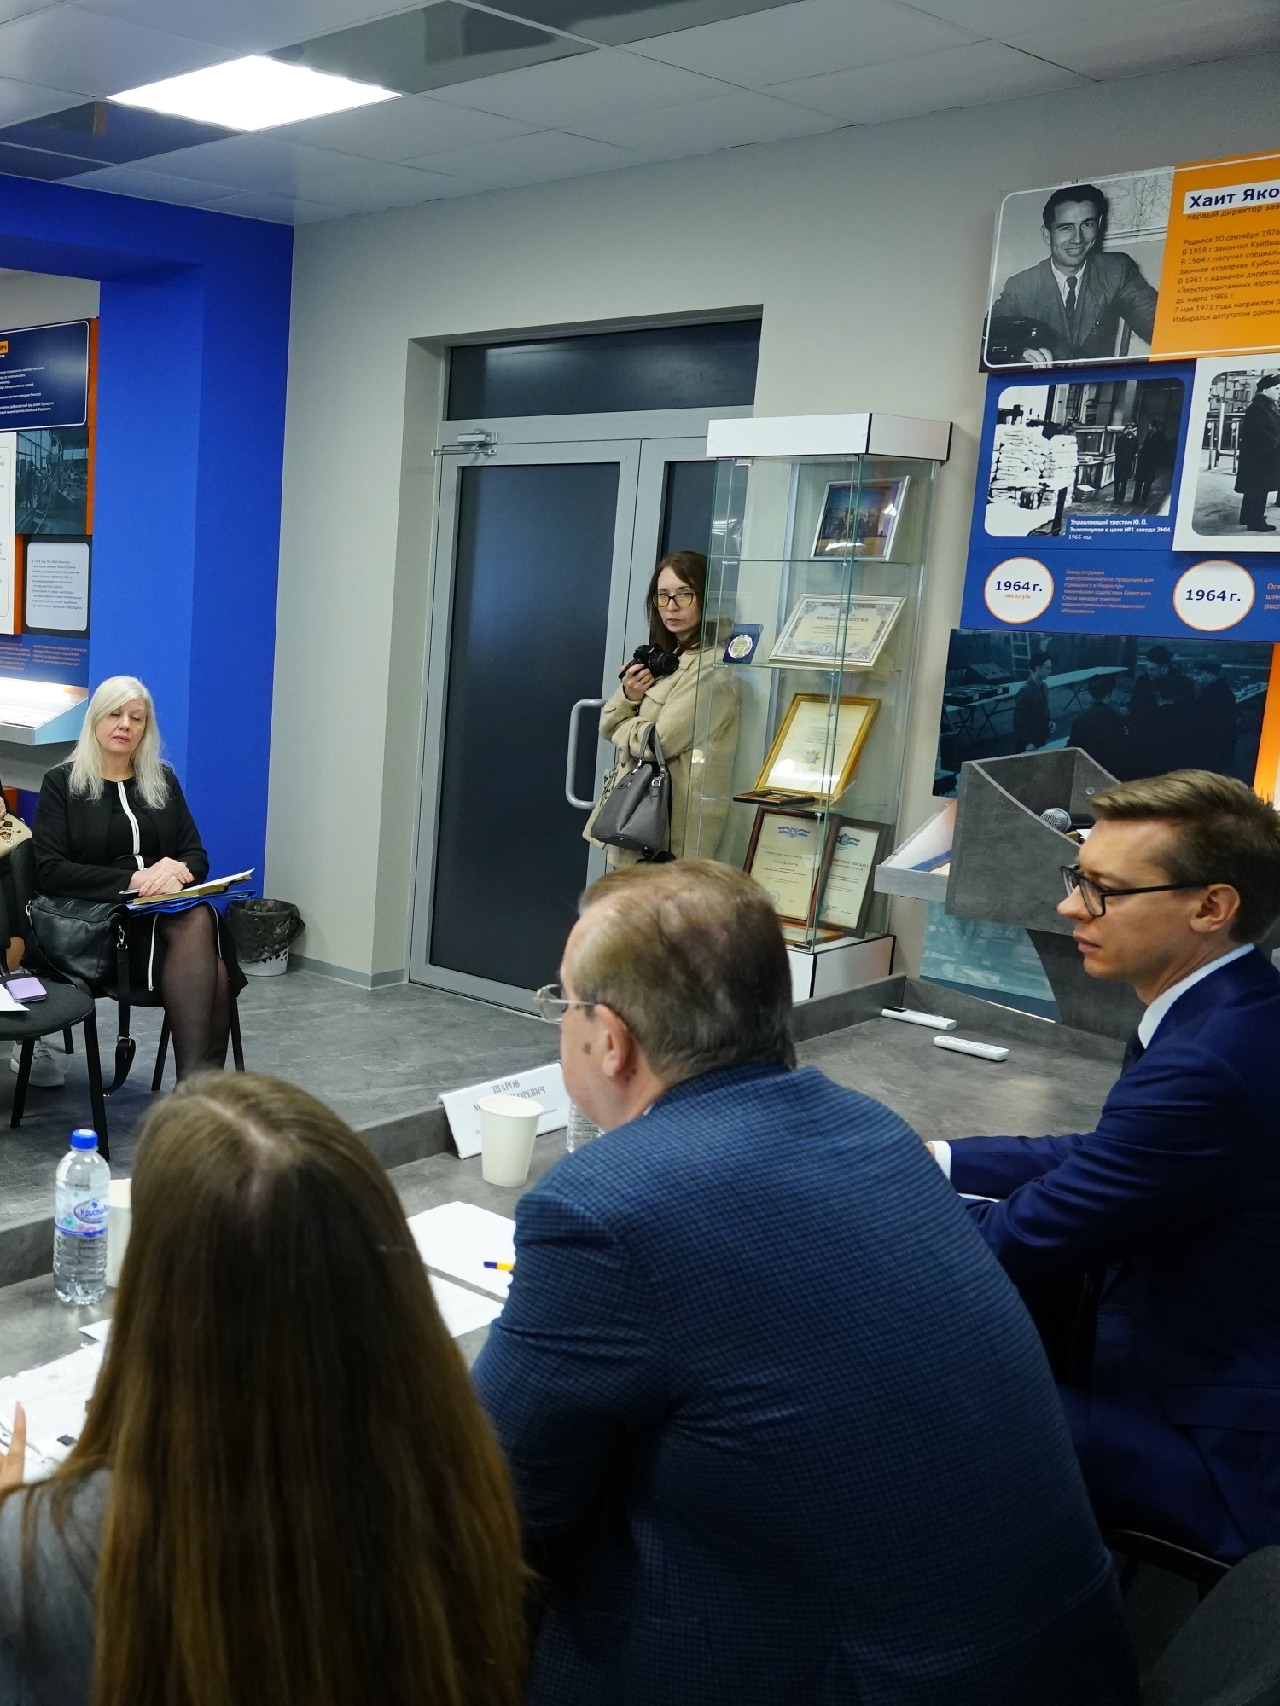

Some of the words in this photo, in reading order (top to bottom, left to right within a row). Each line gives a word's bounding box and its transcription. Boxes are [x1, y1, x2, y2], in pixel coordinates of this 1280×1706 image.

[1189, 194, 1236, 209] Хаит
[1221, 206, 1262, 217] директор
[996, 581, 1030, 591] 1964
[1032, 583, 1043, 592] г.
[1186, 589, 1226, 601] 1964
[1230, 593, 1241, 602] г.
[492, 1080, 520, 1094] ШАРОВ
[508, 1086, 546, 1099] ОРЕВИЧ
